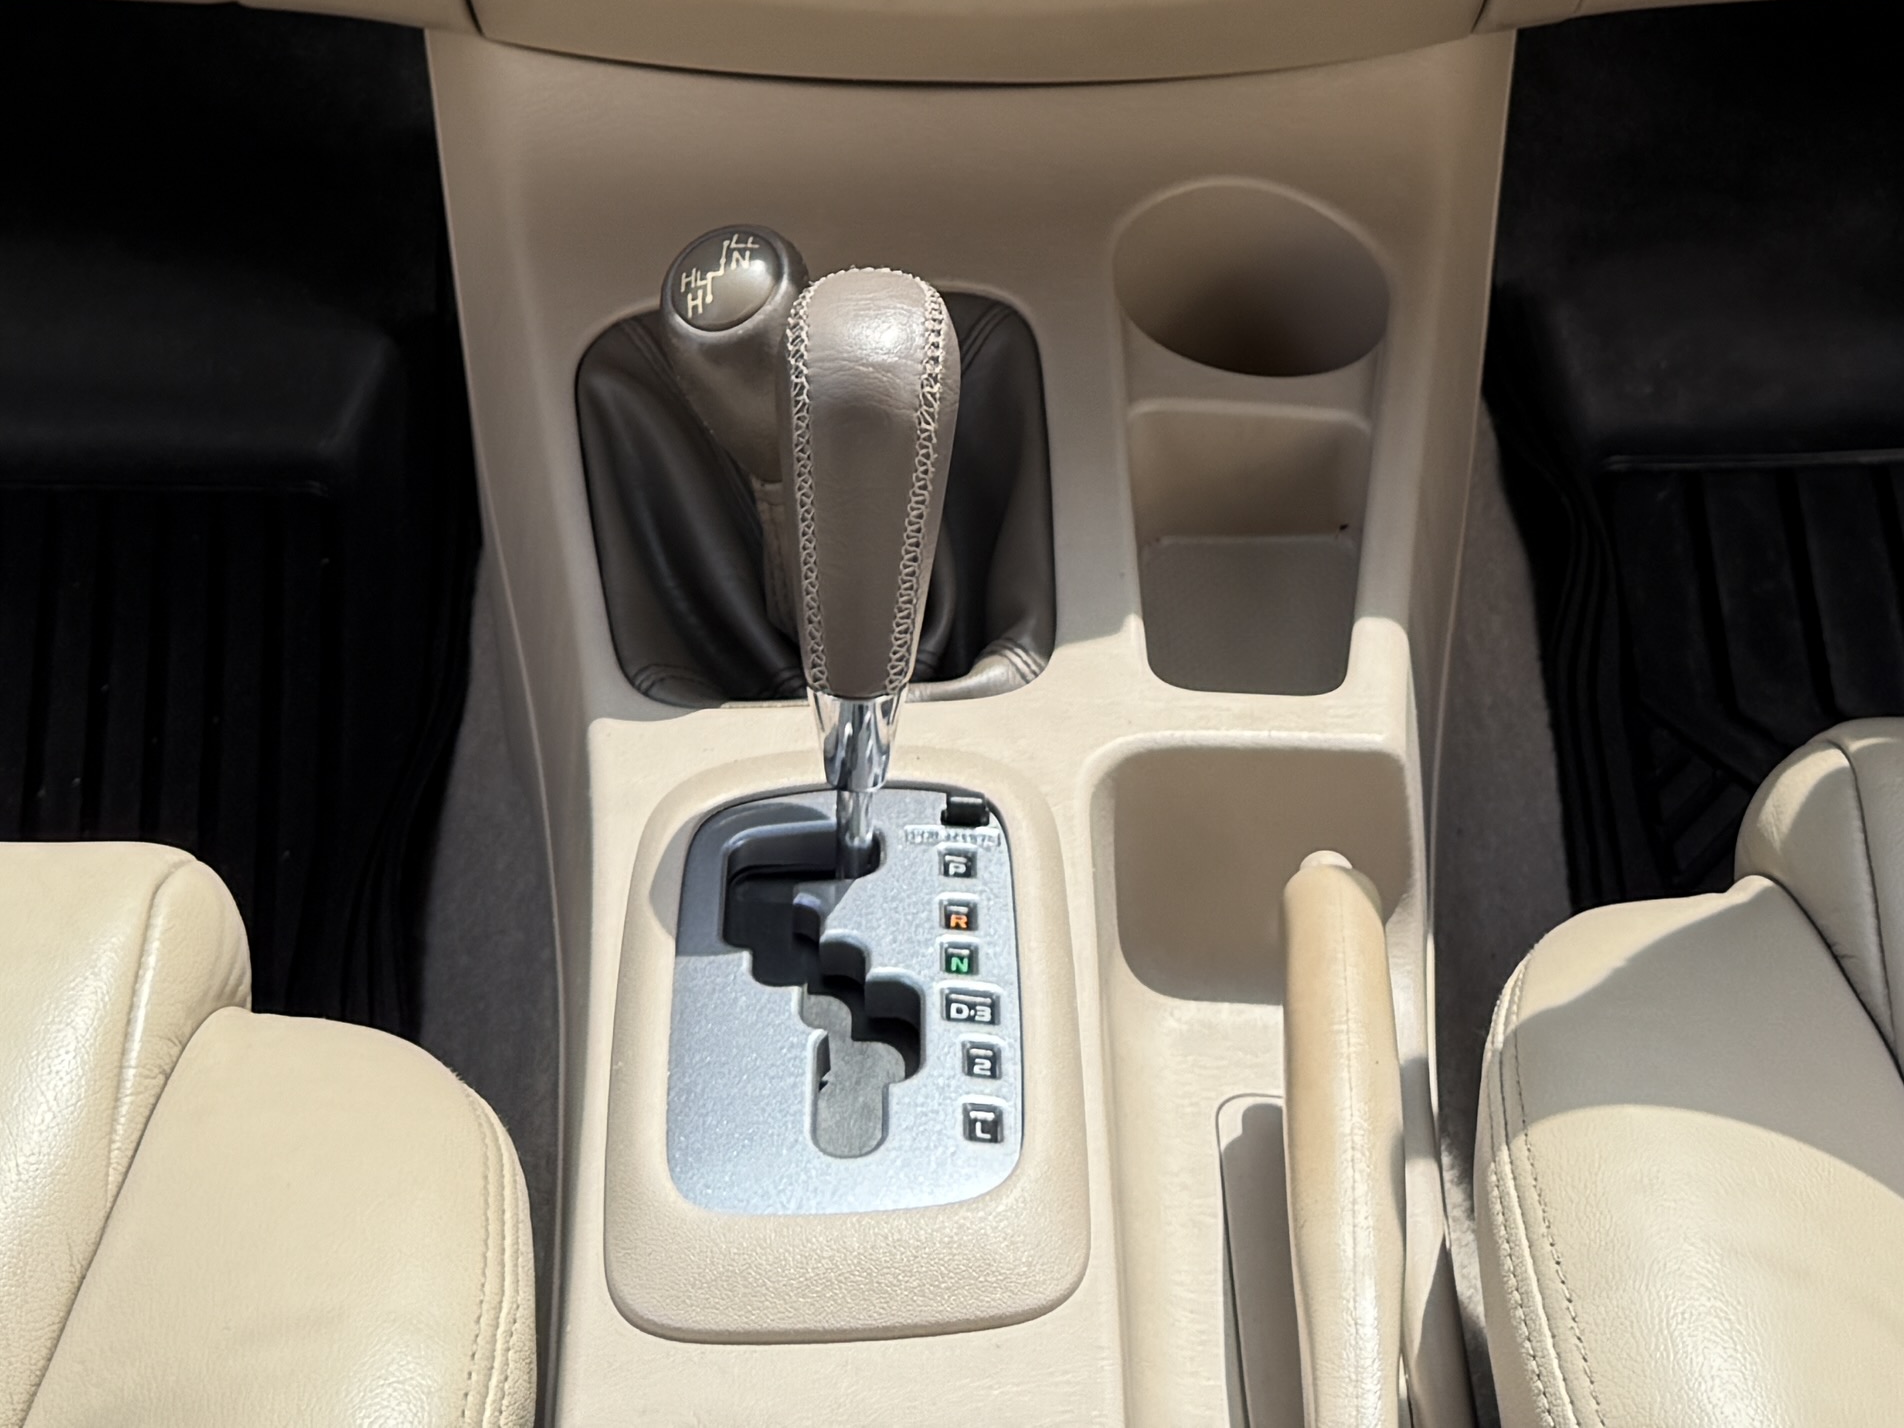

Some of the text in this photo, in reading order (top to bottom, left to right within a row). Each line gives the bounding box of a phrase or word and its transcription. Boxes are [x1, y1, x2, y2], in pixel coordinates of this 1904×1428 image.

[731, 251, 751, 270] N
[687, 291, 703, 319] H
[948, 862, 966, 876] P
[950, 913, 967, 929] R
[950, 956, 969, 973] N
[973, 1059, 991, 1075] 2
[975, 1123, 990, 1139] L
